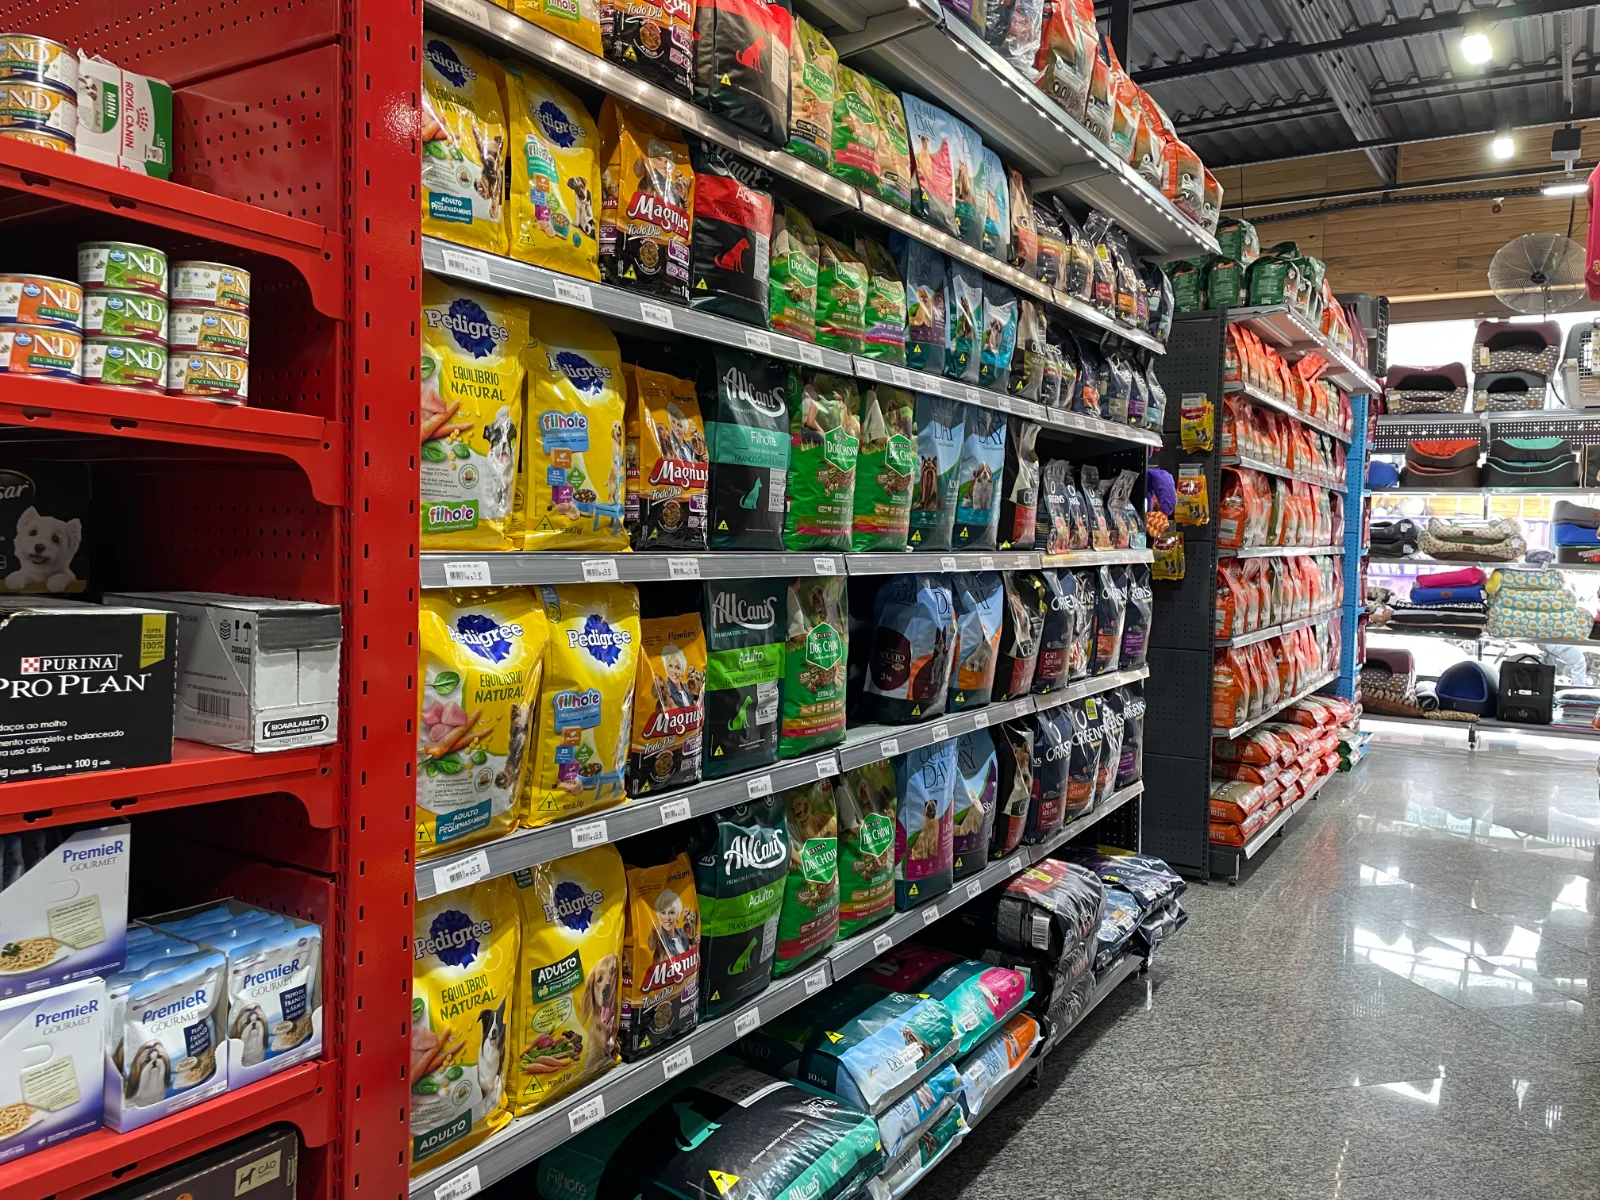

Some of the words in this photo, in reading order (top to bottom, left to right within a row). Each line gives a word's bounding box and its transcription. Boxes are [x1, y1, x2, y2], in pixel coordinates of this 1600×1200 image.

[627, 3, 647, 15] Todo
[423, 50, 477, 80] edigree
[106, 91, 116, 119] MINI
[125, 81, 134, 113] ROYAL
[529, 102, 586, 138] Pedigree
[912, 99, 936, 119] QUALI
[125, 114, 134, 148] CANIN
[915, 115, 937, 136] DAY
[628, 195, 688, 232] Magnus
[628, 224, 647, 235] Todo
[127, 252, 163, 276] N&D
[41, 286, 80, 311] N&D
[41, 308, 77, 321] PUMPKIN
[125, 299, 162, 322] N&D
[424, 308, 510, 342] Pedigree
[33, 334, 74, 357] N&D
[32, 356, 71, 367] PUMPKIN
[126, 348, 162, 370] N&D
[547, 353, 612, 379] Pdigree
[205, 360, 241, 381] N&D
[452, 365, 500, 386] EQUILÍBRIO
[451, 383, 506, 402] NATURAL
[543, 412, 588, 430] filhote
[934, 416, 955, 441] DAY
[650, 460, 709, 488] Magnus
[429, 505, 474, 524] filhote
[712, 591, 777, 630] AllCanis
[142, 641, 165, 650] 100%
[447, 622, 524, 647] Pedigree
[567, 629, 632, 648] Pedigree
[43, 658, 114, 671] PURINA
[739, 650, 764, 665] Adulto
[57, 674, 147, 696] PLAN
[475, 687, 526, 704] NATURAL
[557, 691, 599, 711] filhote
[41, 720, 67, 728] molho
[271, 717, 321, 731] BIOAVAILABILITY
[643, 708, 703, 737] Magnus
[25, 735, 65, 746] completo
[74, 730, 124, 740] balanceado
[26, 746, 50, 754] diário
[31, 764, 43, 773] 15
[75, 759, 91, 768] 100
[92, 759, 98, 767] g
[453, 809, 479, 822] ADULTO
[62, 841, 124, 864] PremieR
[724, 829, 787, 876] AllCanis
[70, 856, 117, 873] GOURMET
[667, 870, 690, 886] remium
[541, 889, 603, 924] Pedigree
[748, 889, 775, 908] Adulto
[414, 918, 494, 960] Pedigree
[243, 958, 300, 989] PremieR
[538, 957, 577, 984] ADULTO
[642, 952, 700, 992] Magnus
[251, 976, 294, 998] GOURMET
[441, 973, 488, 1004] EQUILÍBRIO
[35, 1000, 99, 1028] PremieR
[142, 989, 207, 1025] PremieR
[440, 987, 498, 1022] NATURAL
[43, 1016, 92, 1036] GOURMET
[420, 1119, 467, 1151] ADULTO
[258, 1160, 276, 1174] CÃO
[547, 1167, 588, 1197] Filhote
